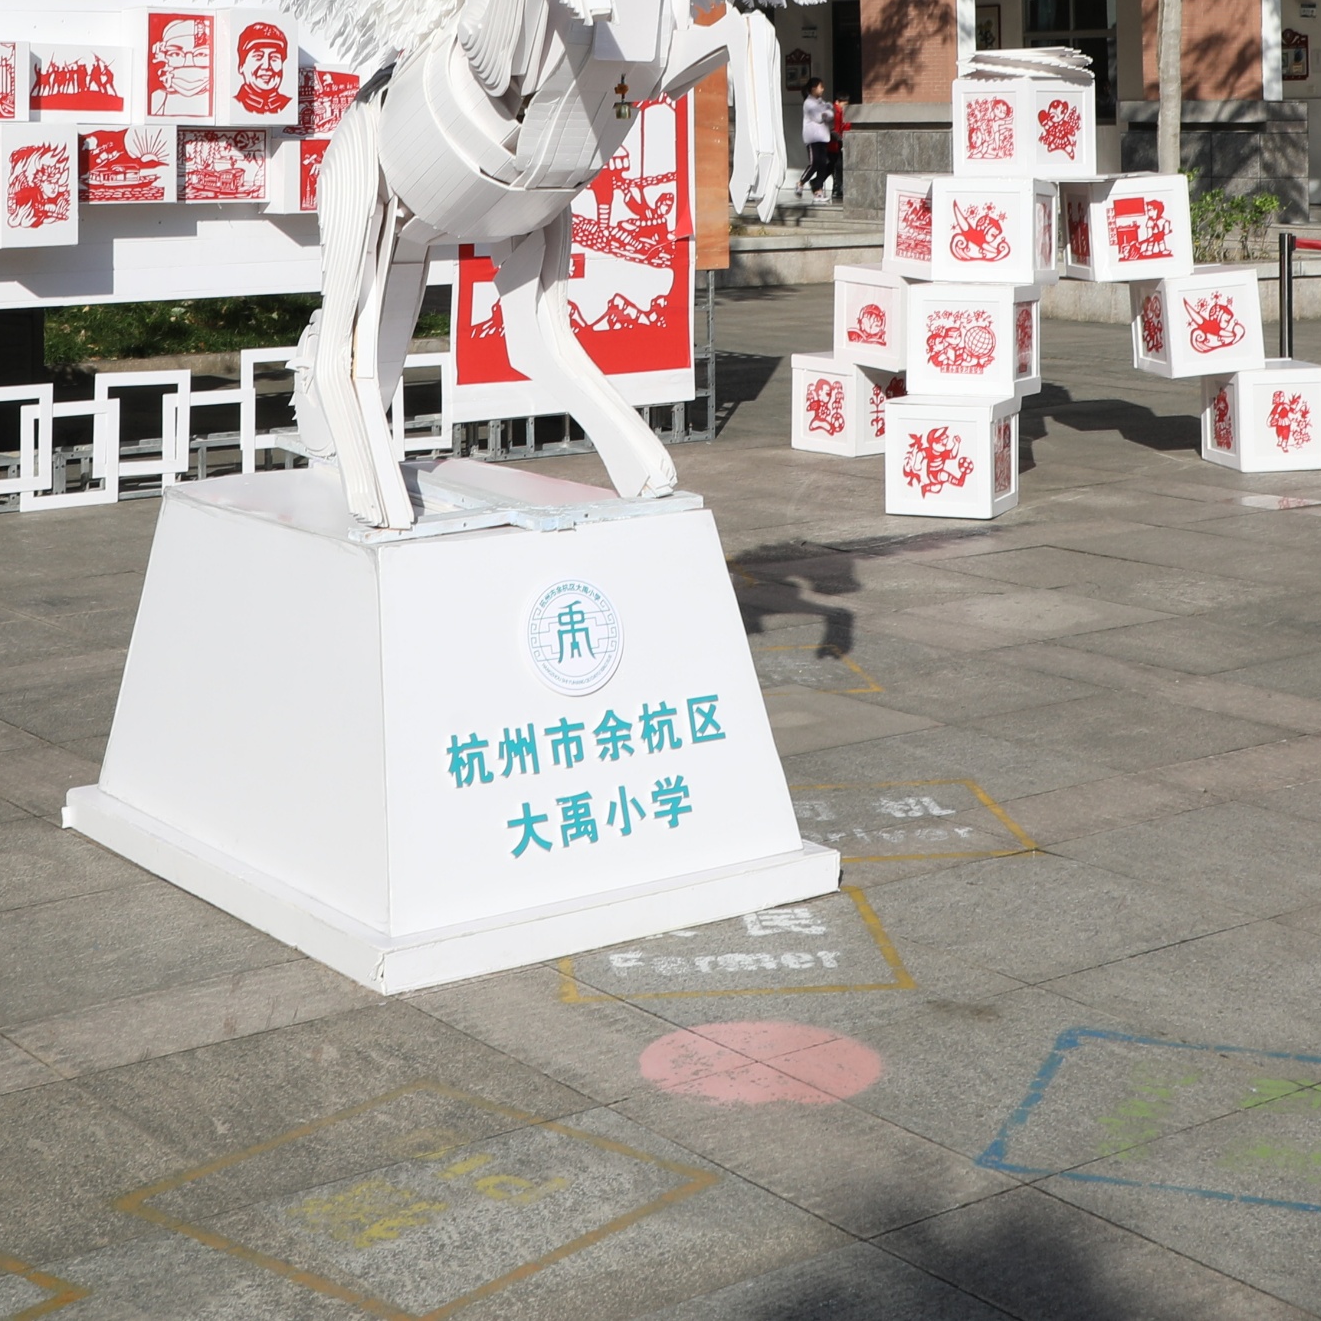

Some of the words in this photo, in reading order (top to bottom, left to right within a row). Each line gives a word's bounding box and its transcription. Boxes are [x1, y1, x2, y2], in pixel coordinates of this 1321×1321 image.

[446, 694, 727, 788] 杭州市余杭区
[507, 774, 693, 859] 大禹小学
